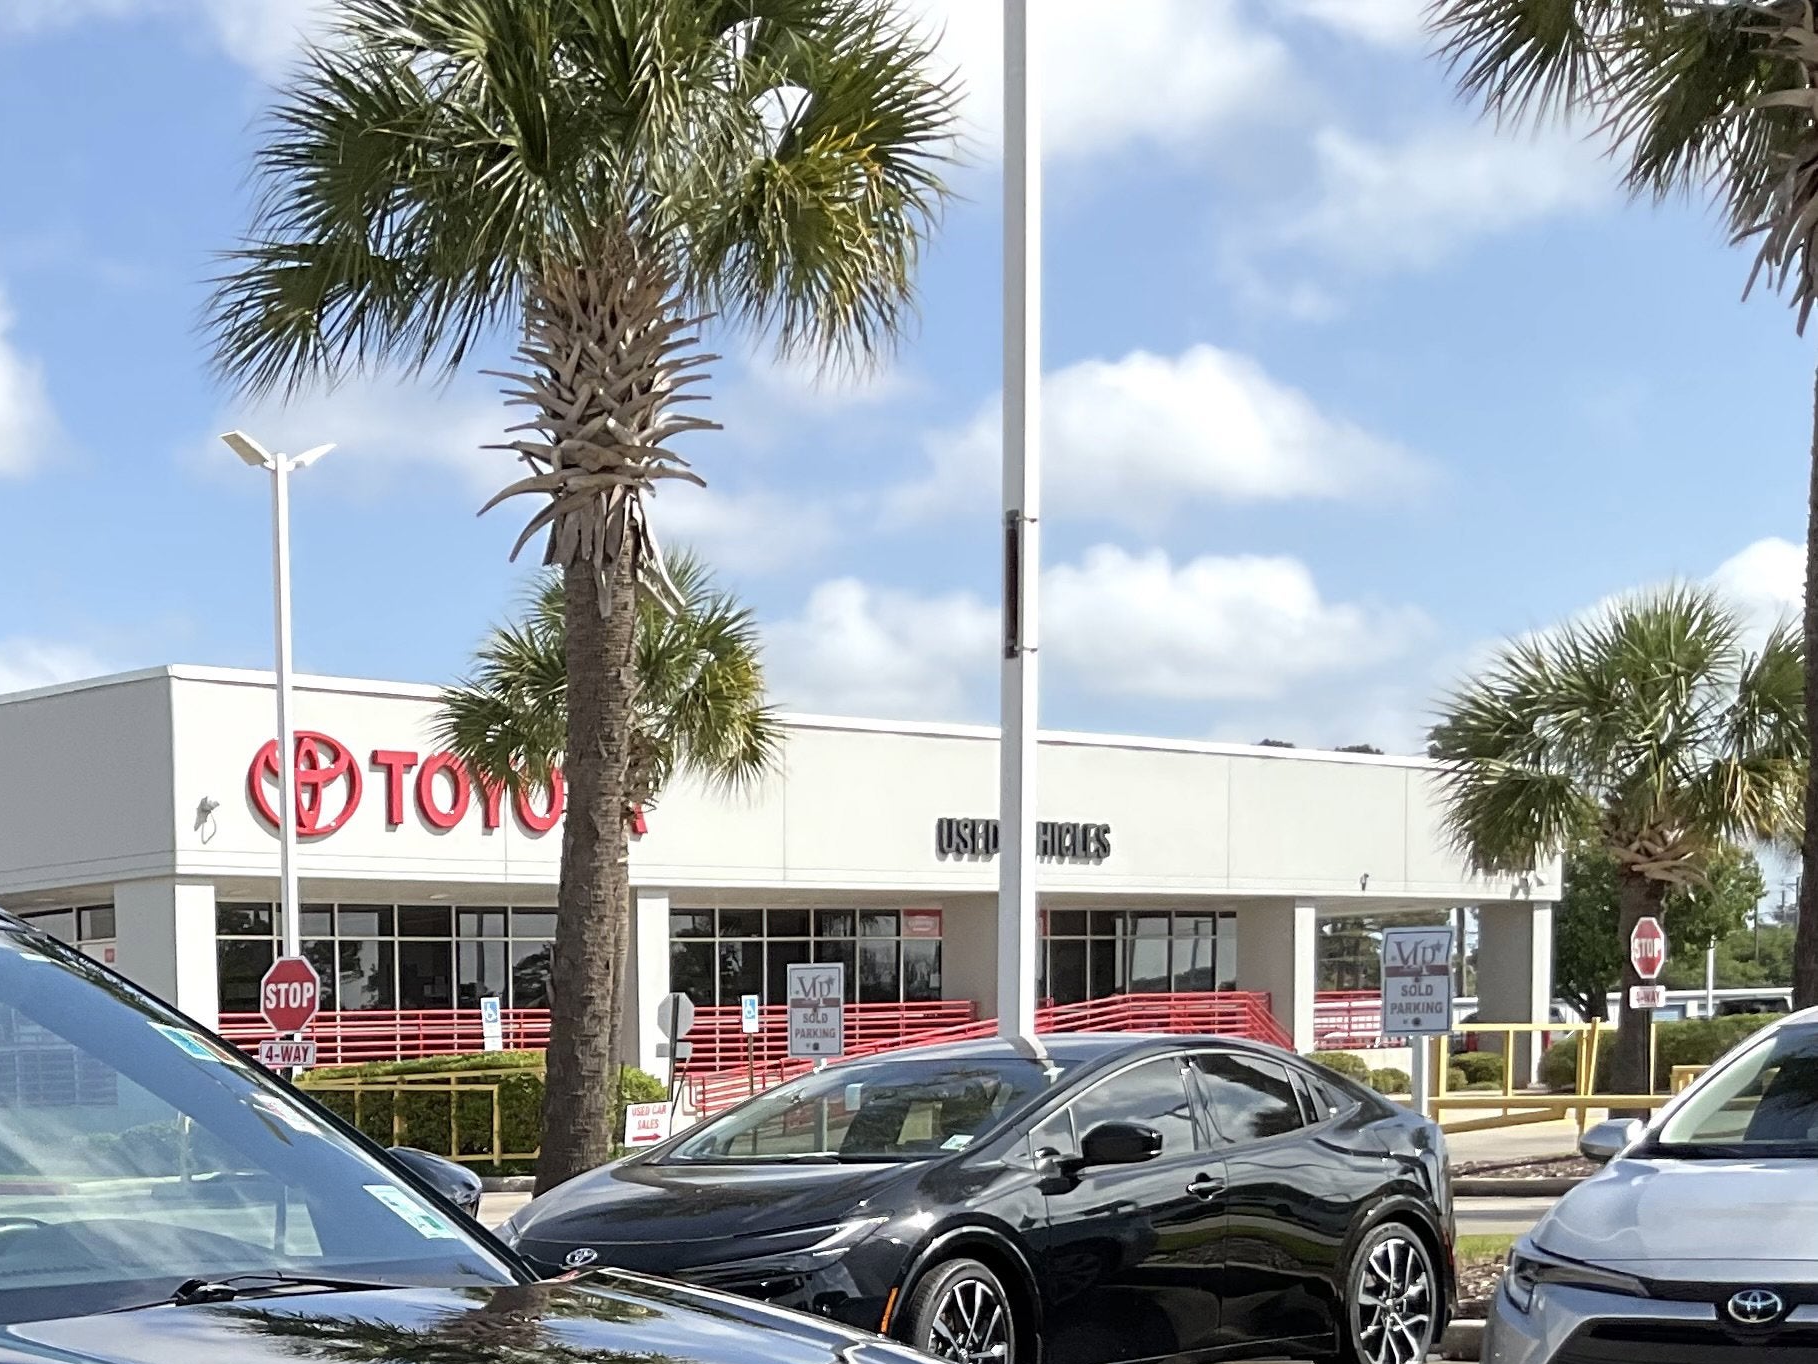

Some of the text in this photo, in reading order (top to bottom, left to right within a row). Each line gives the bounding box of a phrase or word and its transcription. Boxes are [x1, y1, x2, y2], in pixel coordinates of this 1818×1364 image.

[372, 750, 648, 835] TOYO
[936, 818, 1111, 859] USED HICLES
[1634, 938, 1662, 959] STOP
[265, 982, 314, 1009] STOP
[1401, 984, 1434, 997] SOLD
[1390, 1002, 1444, 1015] PARKING
[803, 1013, 829, 1024] SOLD
[794, 1028, 836, 1039] PARKING
[265, 1045, 310, 1062] 4-WAY
[632, 1104, 667, 1116] USED CAR
[637, 1119, 660, 1130] SALES
